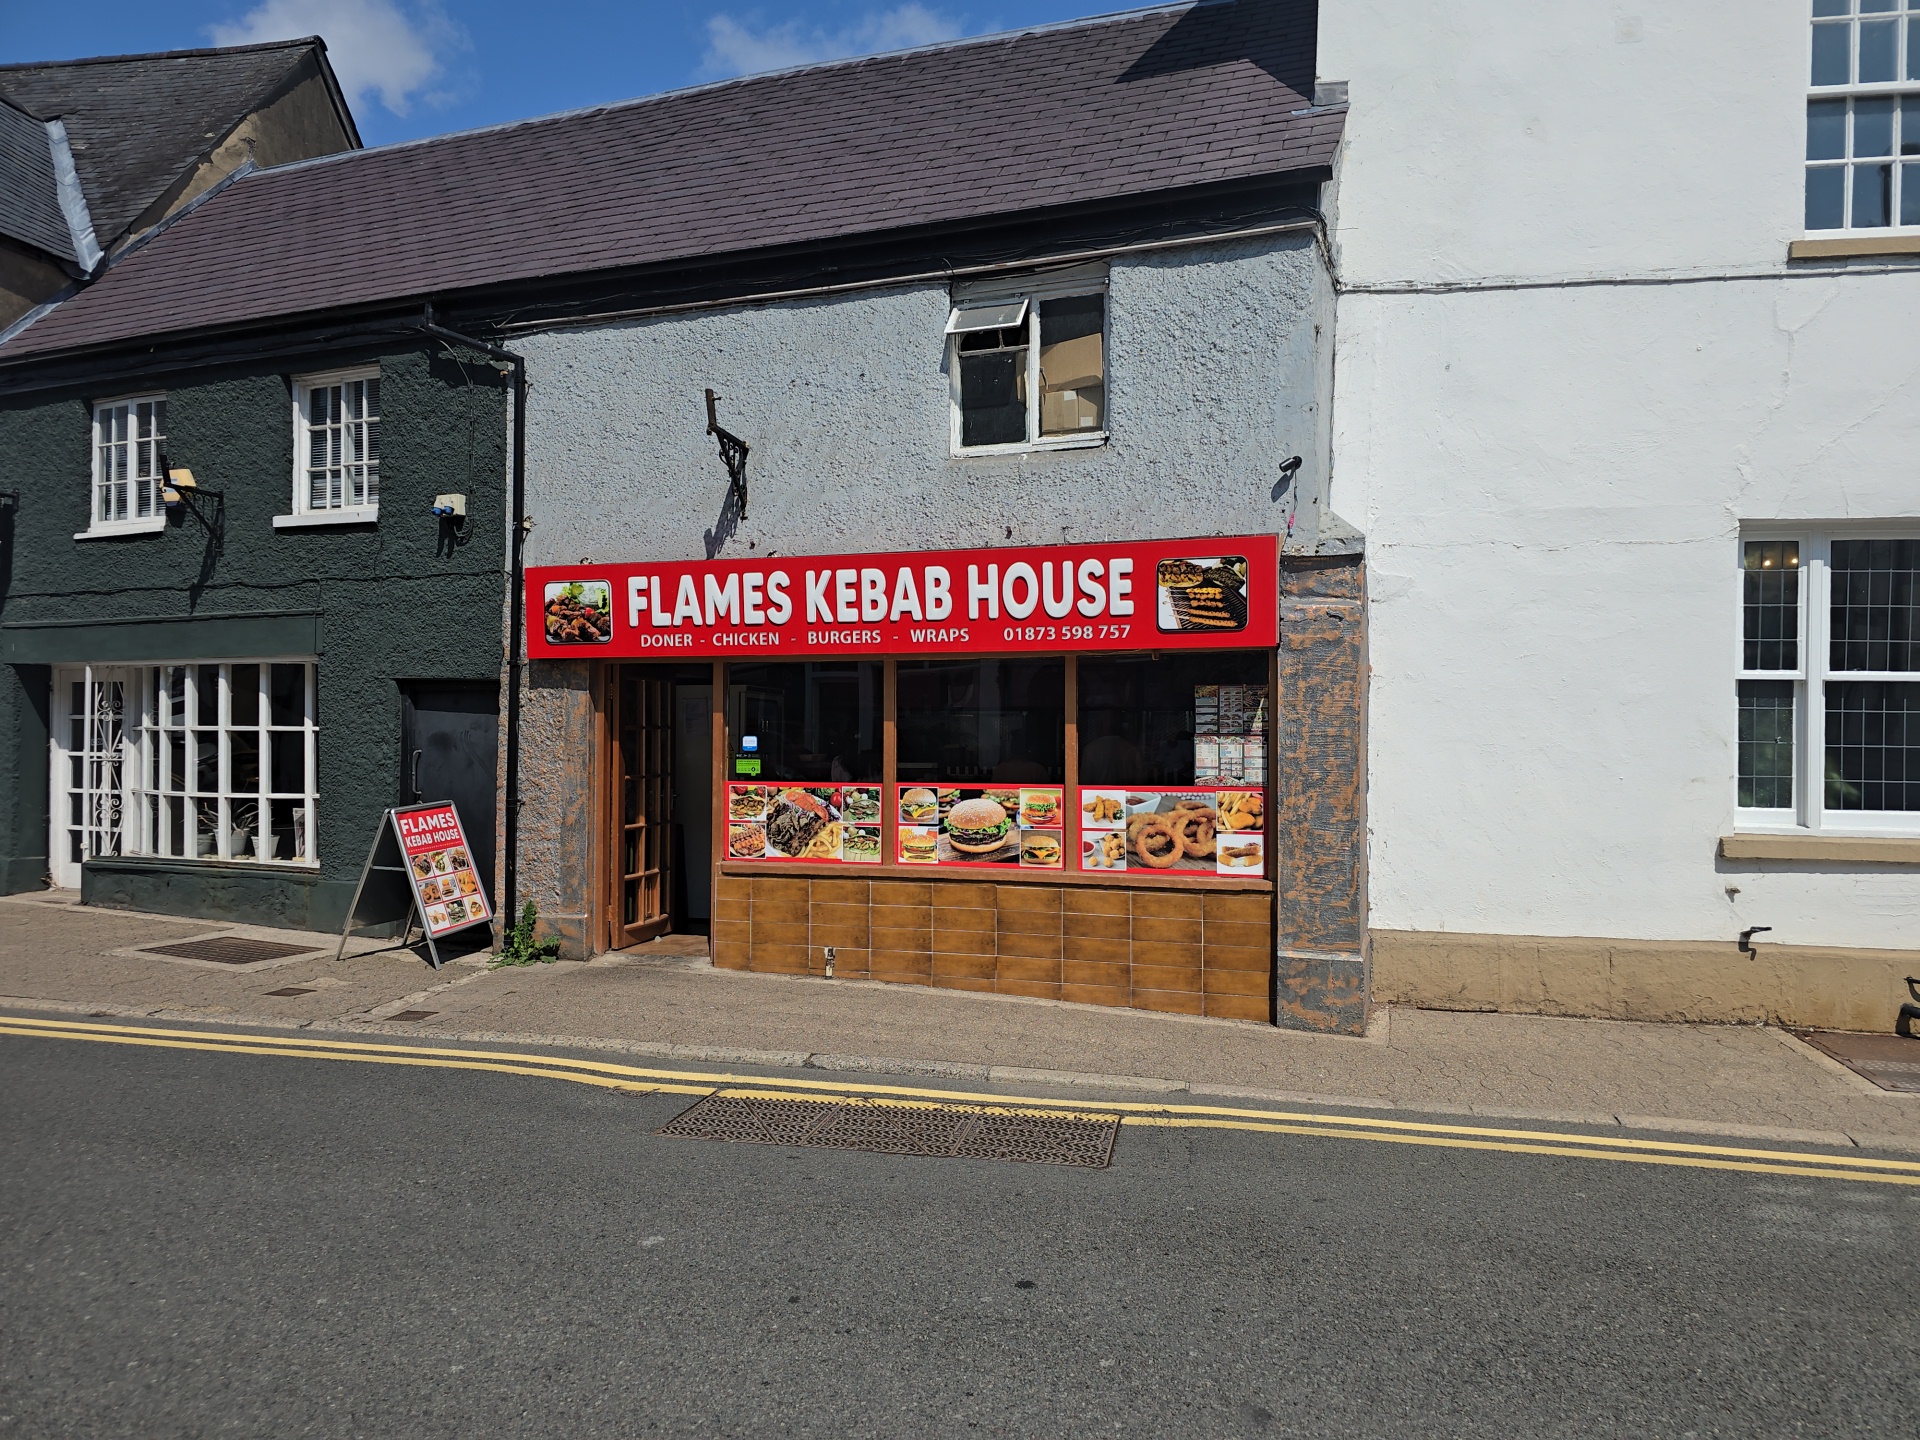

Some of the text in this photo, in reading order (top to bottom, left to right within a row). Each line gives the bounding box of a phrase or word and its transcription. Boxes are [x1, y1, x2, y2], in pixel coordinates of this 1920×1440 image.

[627, 557, 1135, 627] FLAMES KEBAB HOUSE
[640, 633, 693, 648] DONER
[712, 632, 780, 646] CHICKEN
[807, 629, 882, 645] BURGERS
[910, 628, 970, 643] WRAPS
[1003, 626, 1056, 641] 01873
[1061, 624, 1093, 640] 598
[1098, 624, 1131, 639] 757
[400, 812, 455, 834] FLAMES
[405, 833, 432, 848] KEBAB
[433, 829, 460, 843] HOUSE
